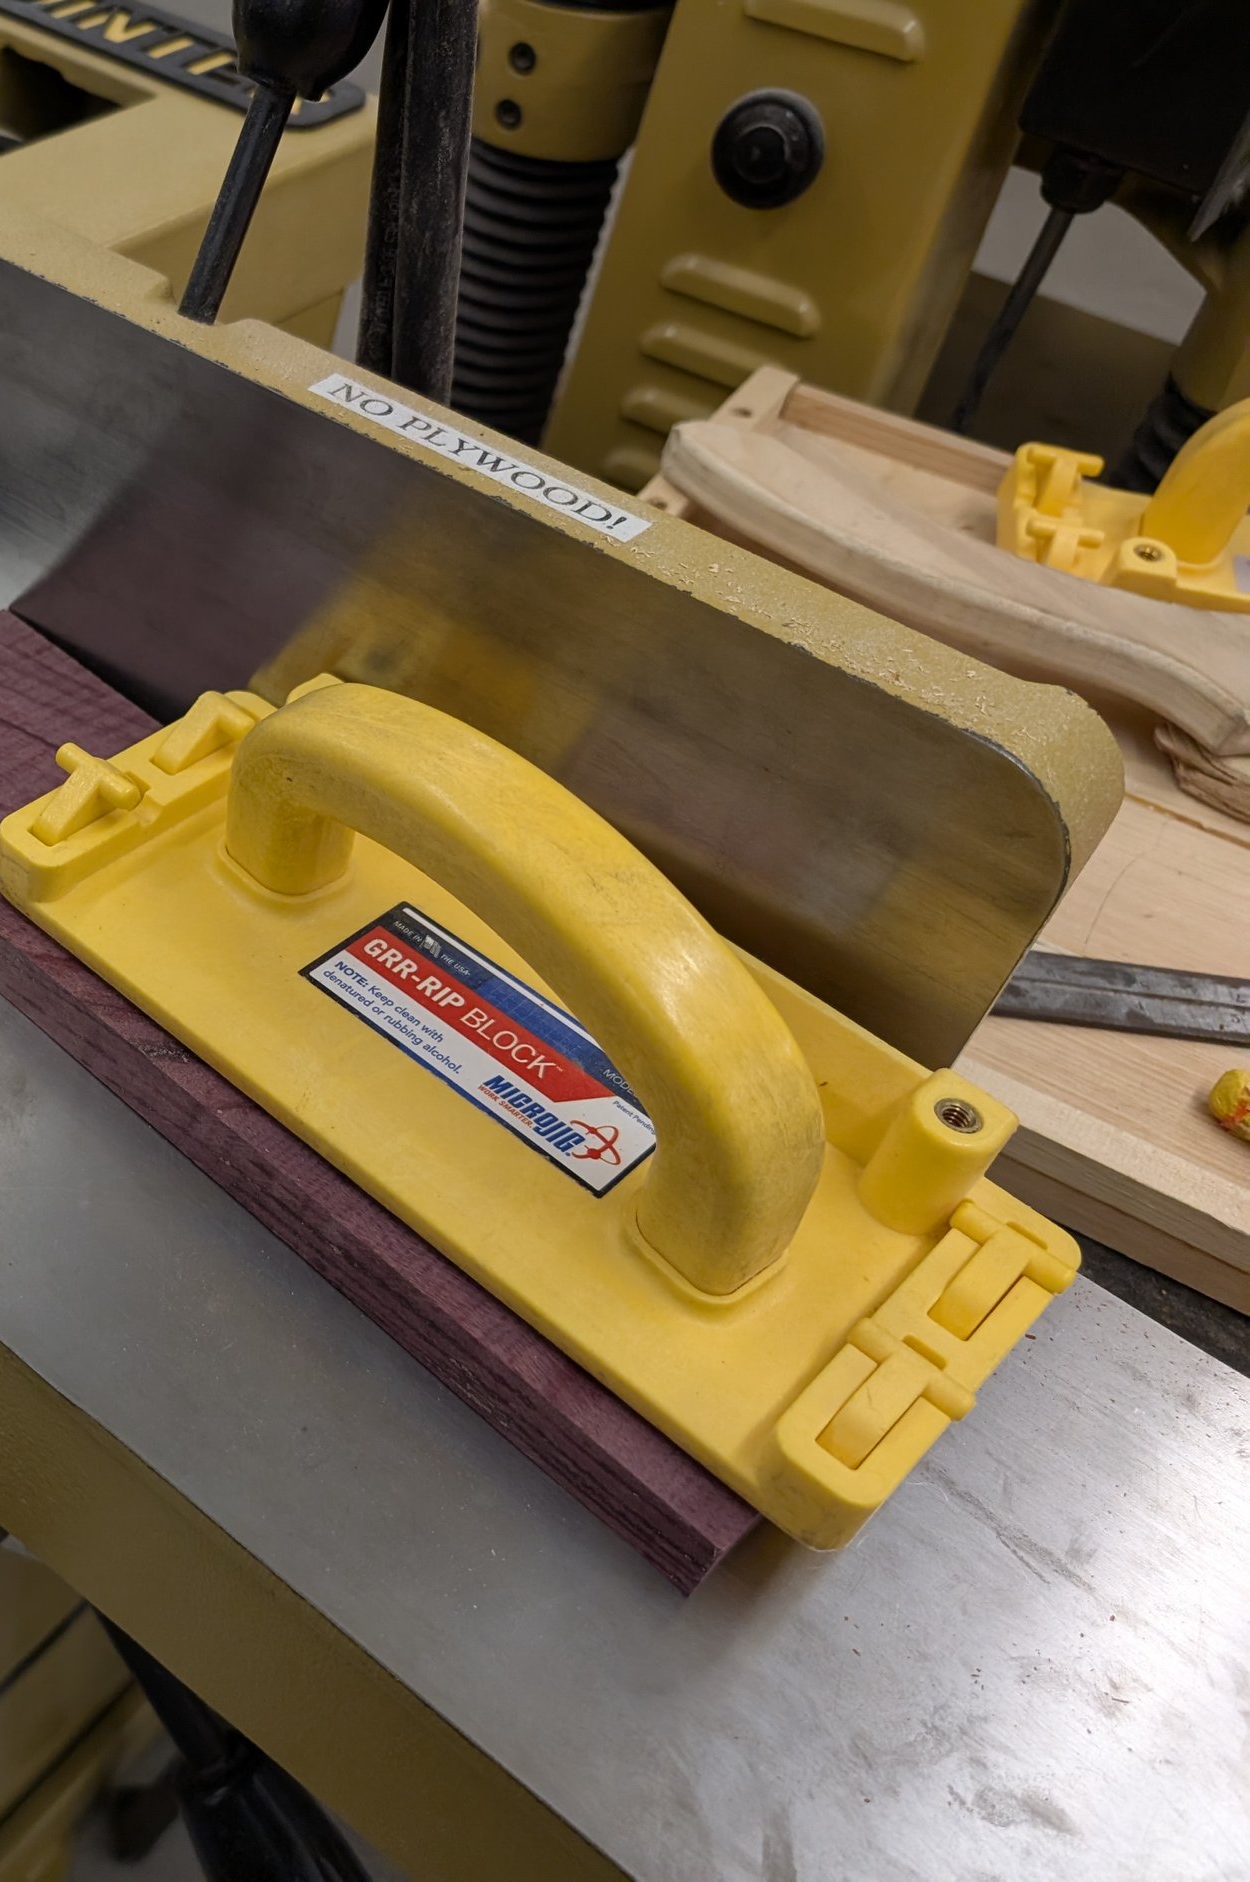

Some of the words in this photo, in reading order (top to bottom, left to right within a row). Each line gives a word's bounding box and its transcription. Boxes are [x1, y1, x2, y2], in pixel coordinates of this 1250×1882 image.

[328, 383, 393, 416] NO
[398, 416, 627, 530] PLYWOOD!
[363, 938, 465, 1008] GRR-RIP
[393, 920, 414, 937] MADE
[413, 934, 423, 943] IN
[440, 954, 454, 965] THE
[323, 969, 373, 1008] denatured
[371, 1005, 385, 1017] or
[383, 1014, 423, 1046] rubbing
[422, 1042, 462, 1074] alcohol.
[334, 960, 369, 988] NOTE:
[367, 984, 395, 1008] Keep
[394, 1005, 421, 1028] clean
[421, 1024, 444, 1043] with
[478, 1084, 499, 1102] WORK
[498, 1100, 534, 1128] SMARTER.
[612, 1100, 634, 1117] Patent
